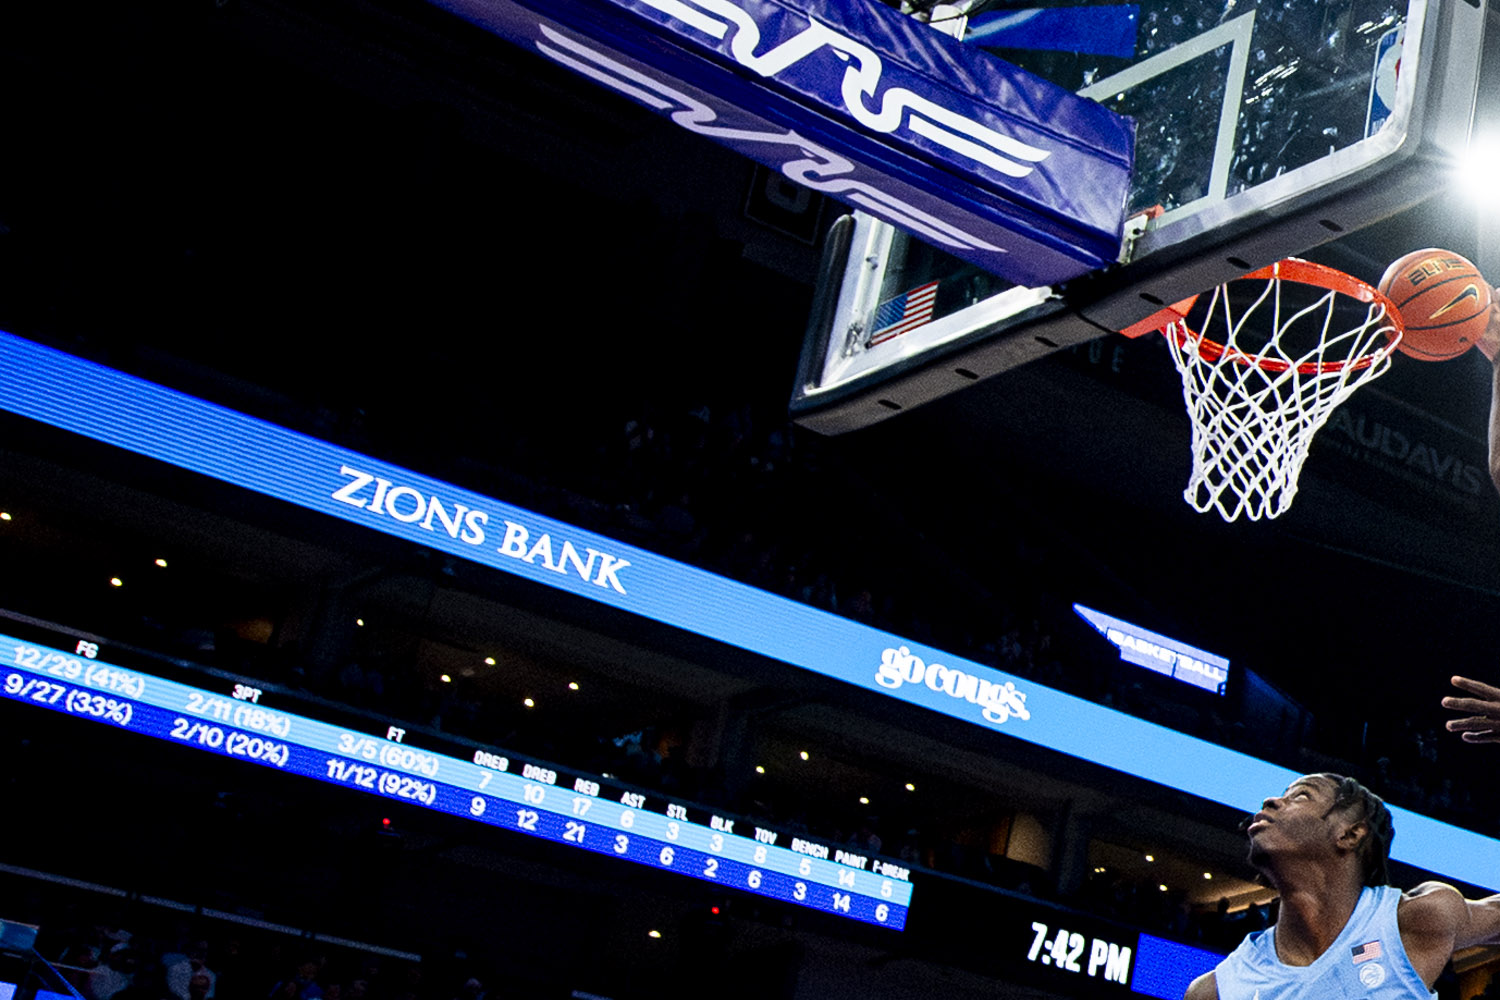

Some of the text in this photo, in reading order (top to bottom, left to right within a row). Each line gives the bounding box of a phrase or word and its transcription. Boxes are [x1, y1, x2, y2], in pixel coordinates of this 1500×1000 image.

[332, 465, 631, 595] ZIONS BANK
[4, 673, 889, 922] 9/27 (33%) 2/10 (20%) 11/12 (92%) 9 12 21 3 6 2 6 3 14 6
[13, 645, 83, 679] 12/29
[84, 663, 146, 699] (41%)
[185, 692, 233, 722] 2/11
[337, 733, 381, 760] 3/5
[379, 743, 440, 779] (60%)
[477, 770, 494, 789] 7
[523, 783, 546, 805] 10
[571, 796, 593, 818] 17
[619, 810, 636, 829] 6
[665, 822, 681, 842] 3
[709, 834, 725, 853] 3
[798, 858, 813, 876] 5
[836, 867, 856, 889] 14
[879, 879, 893, 899] 5
[76, 640, 98, 659] FG
[232, 684, 262, 704] 3PT
[387, 726, 406, 743] FT
[573, 777, 600, 797] REB
[620, 791, 645, 809] AST
[667, 803, 688, 821] STL
[710, 815, 734, 834] BLK
[755, 827, 777, 845] TOV
[791, 837, 829, 860] BENCH
[835, 849, 868, 870] PAINT
[1027, 921, 1132, 985] 7:42 PM
